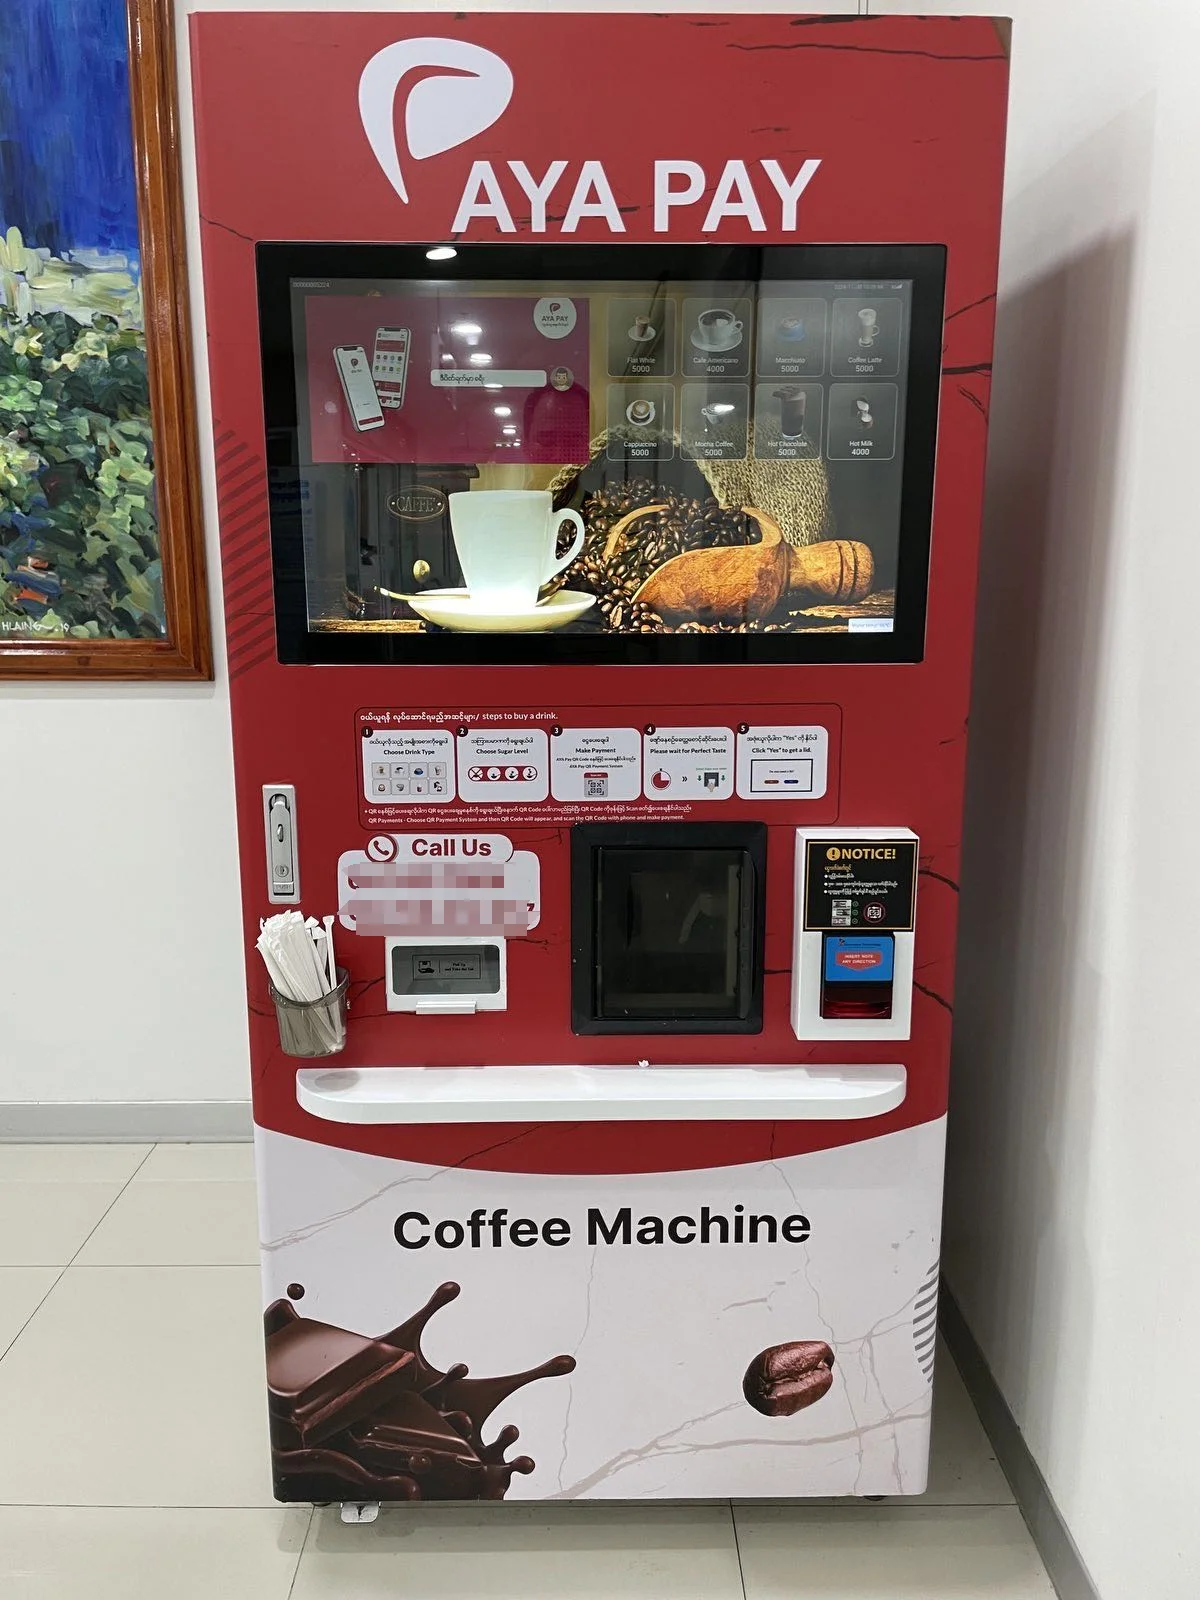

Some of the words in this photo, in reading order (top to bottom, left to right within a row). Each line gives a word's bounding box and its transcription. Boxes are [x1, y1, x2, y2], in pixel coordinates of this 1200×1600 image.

[451, 160, 627, 232] AYA
[654, 159, 822, 232] PAY
[632, 365, 650, 373] 5000
[706, 365, 725, 373] 4000
[623, 441, 657, 449] Cappuccino
[767, 440, 778, 448] Hot
[779, 440, 808, 448] Chocolate
[778, 448, 797, 456] 5000
[851, 448, 870, 456] 4000
[482, 713, 503, 722] steps
[504, 713, 513, 722] to
[513, 713, 529, 722] buy
[529, 713, 535, 722] a
[535, 713, 559, 722] drink.
[411, 838, 456, 857] Call
[462, 838, 492, 857] Us
[841, 848, 897, 860] NOTICE!
[393, 1208, 571, 1250] Coffee
[587, 1204, 811, 1246] Machine
